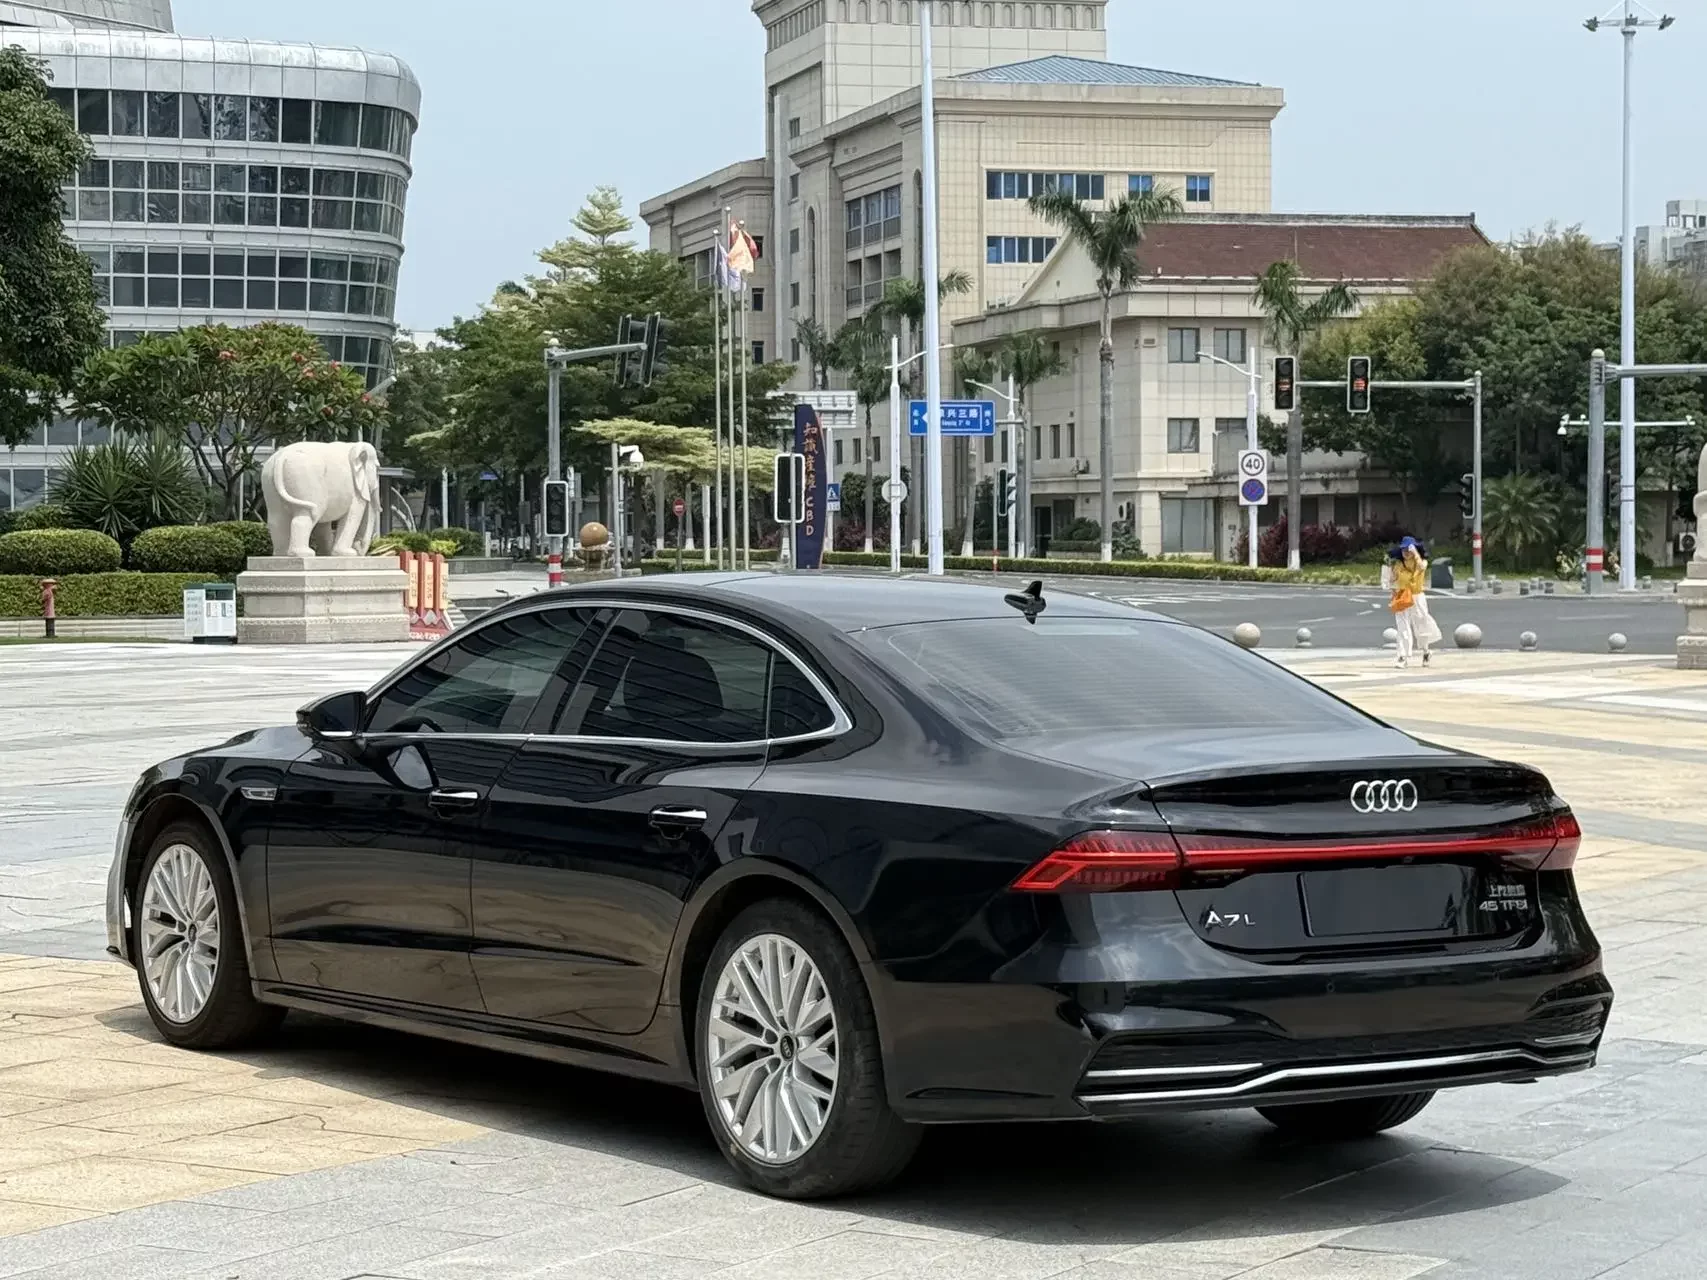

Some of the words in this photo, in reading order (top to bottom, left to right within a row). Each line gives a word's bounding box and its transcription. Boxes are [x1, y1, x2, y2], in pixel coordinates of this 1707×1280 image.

[1245, 458, 1261, 470] 40
[805, 496, 815, 536] CBD
[1479, 900, 1499, 911] 45
[1499, 898, 1528, 911] TFSI
[1204, 910, 1256, 928] A7L
